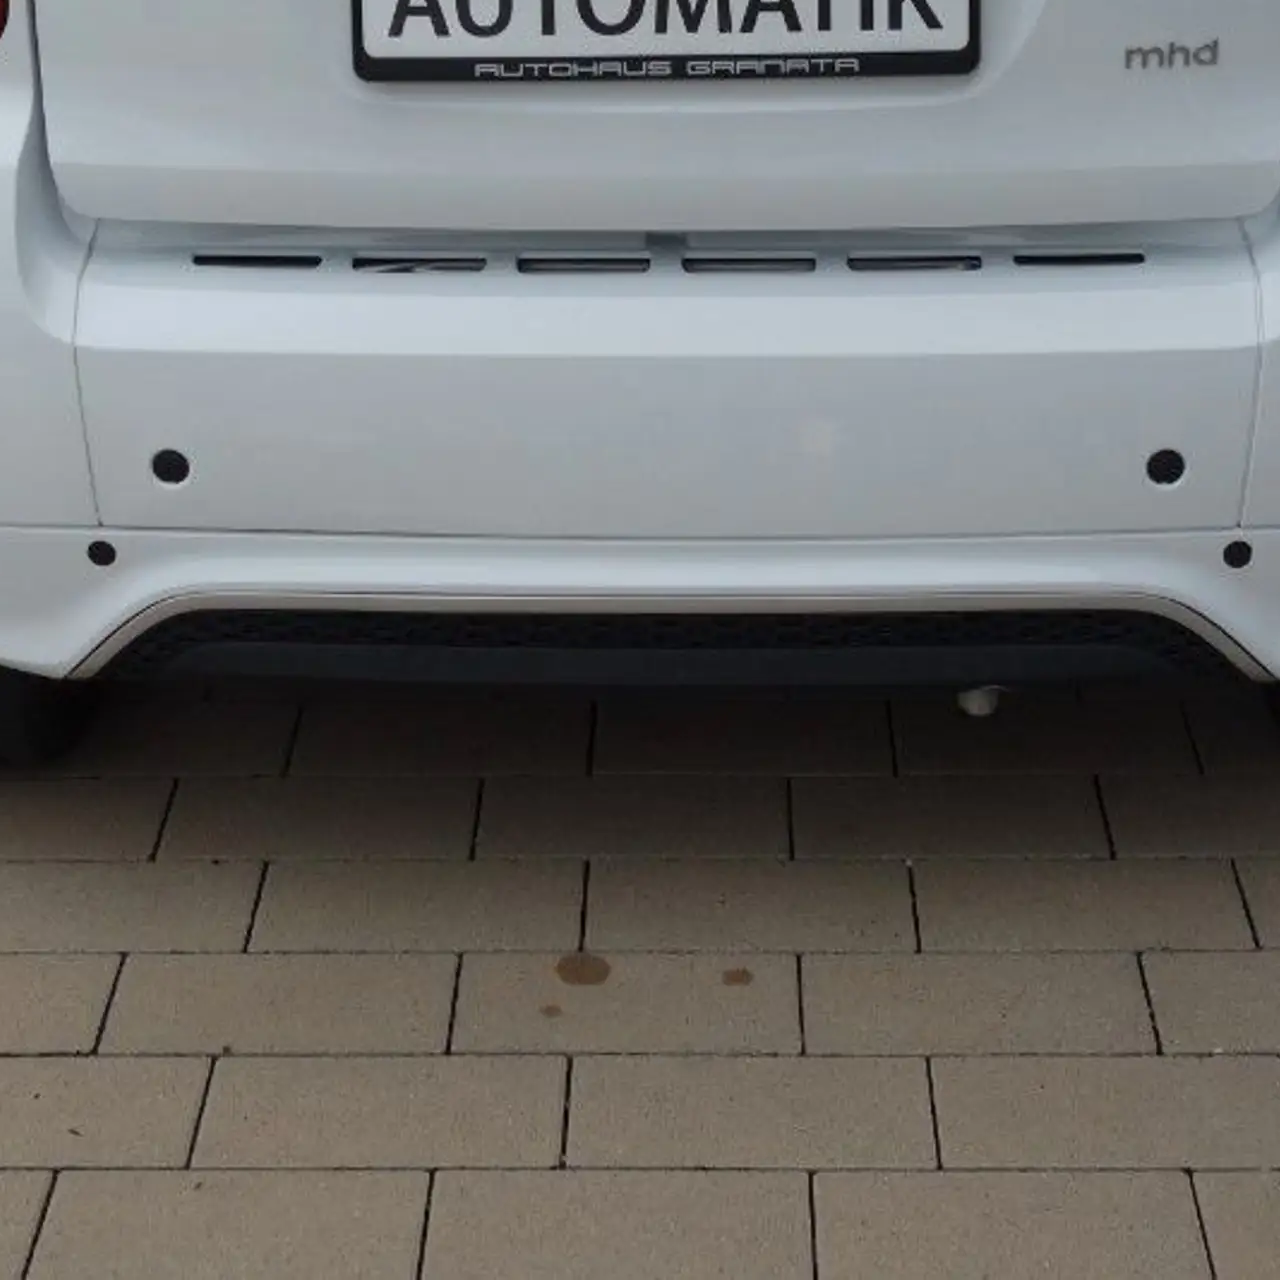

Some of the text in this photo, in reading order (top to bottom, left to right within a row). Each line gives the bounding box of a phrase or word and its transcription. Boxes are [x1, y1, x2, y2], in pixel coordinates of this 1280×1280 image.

[1123, 37, 1220, 70] mhd
[473, 57, 860, 78] AUTOHAUS GRANATA
